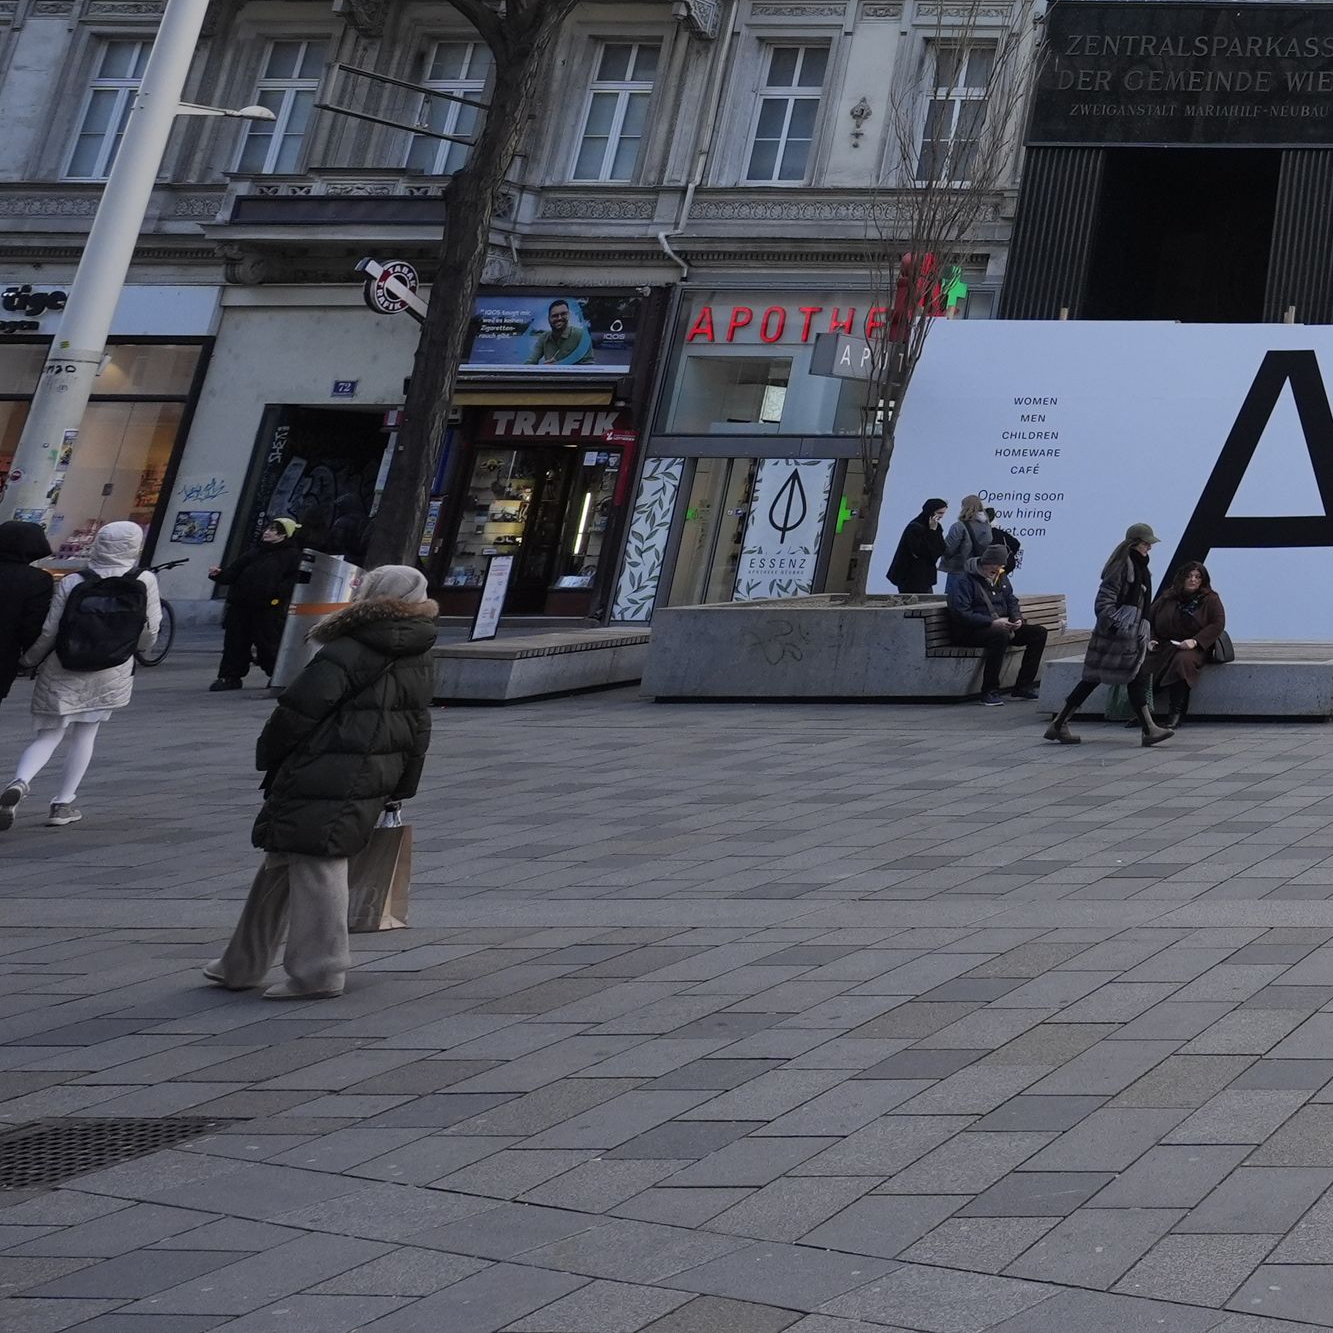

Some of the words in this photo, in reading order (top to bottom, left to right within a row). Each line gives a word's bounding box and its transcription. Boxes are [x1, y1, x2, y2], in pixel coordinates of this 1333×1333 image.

[1057, 69, 1113, 92] DER
[1124, 69, 1272, 93] GEMEINDE
[1068, 103, 1178, 117] ZWEIGANSTALT
[388, 265, 417, 288] TABAK
[2, 284, 68, 317] tige
[375, 280, 402, 310] TRAFIK
[338, 382, 352, 392] 72
[1013, 397, 1058, 406] WOMEN
[493, 410, 619, 436] TRAFIK
[1020, 414, 1046, 423] MEN
[1002, 431, 1059, 440] CHILDREN
[994, 448, 1061, 457] HOMEWARE
[1010, 463, 1040, 475] CAFÉ
[978, 489, 1031, 503] Opening
[1034, 492, 1065, 502] soon
[1016, 507, 1052, 521] hiring
[749, 558, 807, 569] ESSENZ
